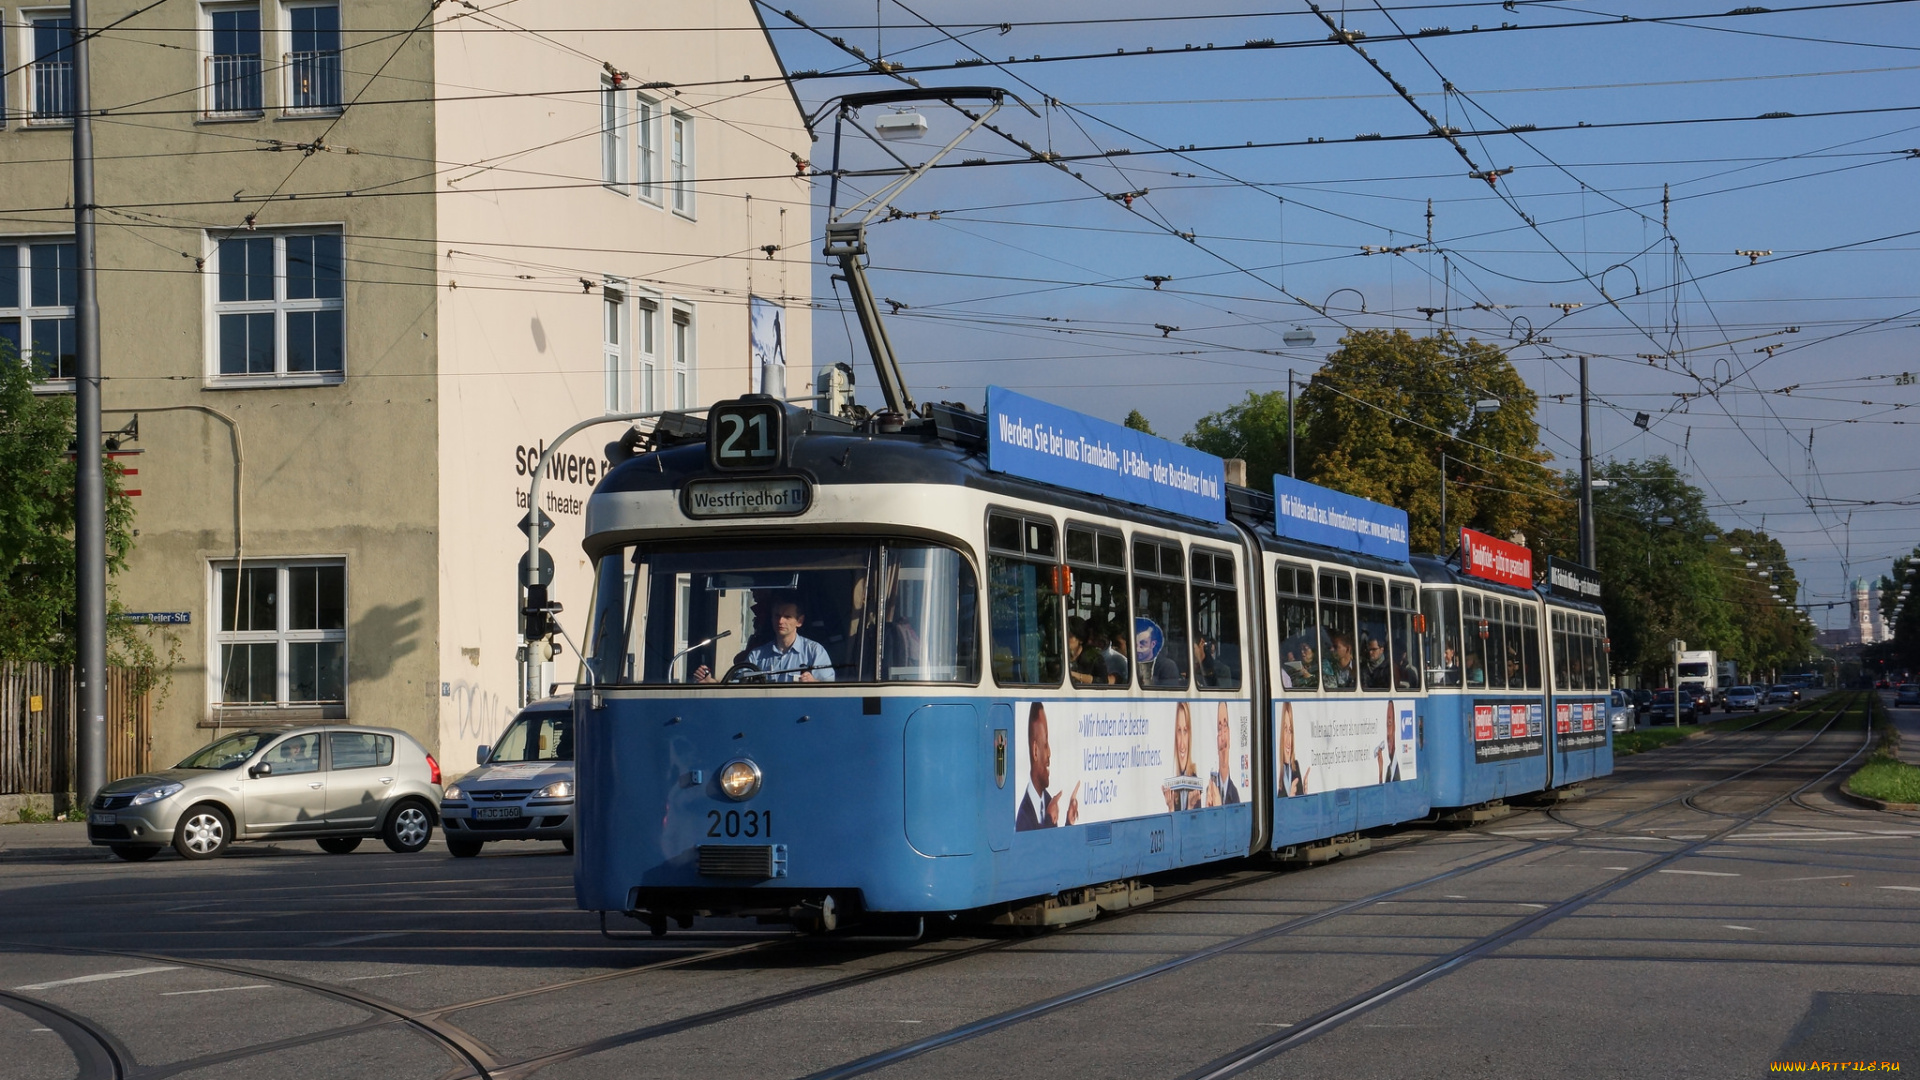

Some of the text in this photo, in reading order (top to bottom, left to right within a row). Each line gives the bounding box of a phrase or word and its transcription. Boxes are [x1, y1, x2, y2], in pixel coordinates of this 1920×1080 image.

[1896, 376, 1915, 386] 251
[720, 413, 776, 458] 21
[516, 438, 596, 486] schwere
[998, 413, 1220, 501] Werden Sie bei uns Trambahn-, U-Bahn- oder Busfahrer (m/w).
[546, 491, 583, 516] theater
[694, 489, 789, 508] Westfriedhof
[1281, 494, 1290, 516] Wir
[1291, 495, 1307, 520] bilden
[1307, 502, 1318, 523] auch
[1319, 508, 1328, 525] aus.
[1328, 506, 1358, 533] Informationen
[1078, 712, 1149, 738] »Wir haben die besten
[1310, 720, 1323, 738] Wollen
[1323, 720, 1332, 737] auch
[1339, 719, 1348, 736] mehr
[1083, 744, 1163, 775] Verbindungen Münchens.
[1311, 749, 1321, 767] Dann
[1321, 751, 1335, 770] steigen
[1083, 780, 1098, 805] Und
[706, 810, 773, 838] 2031
[1150, 830, 1165, 854] 2031
